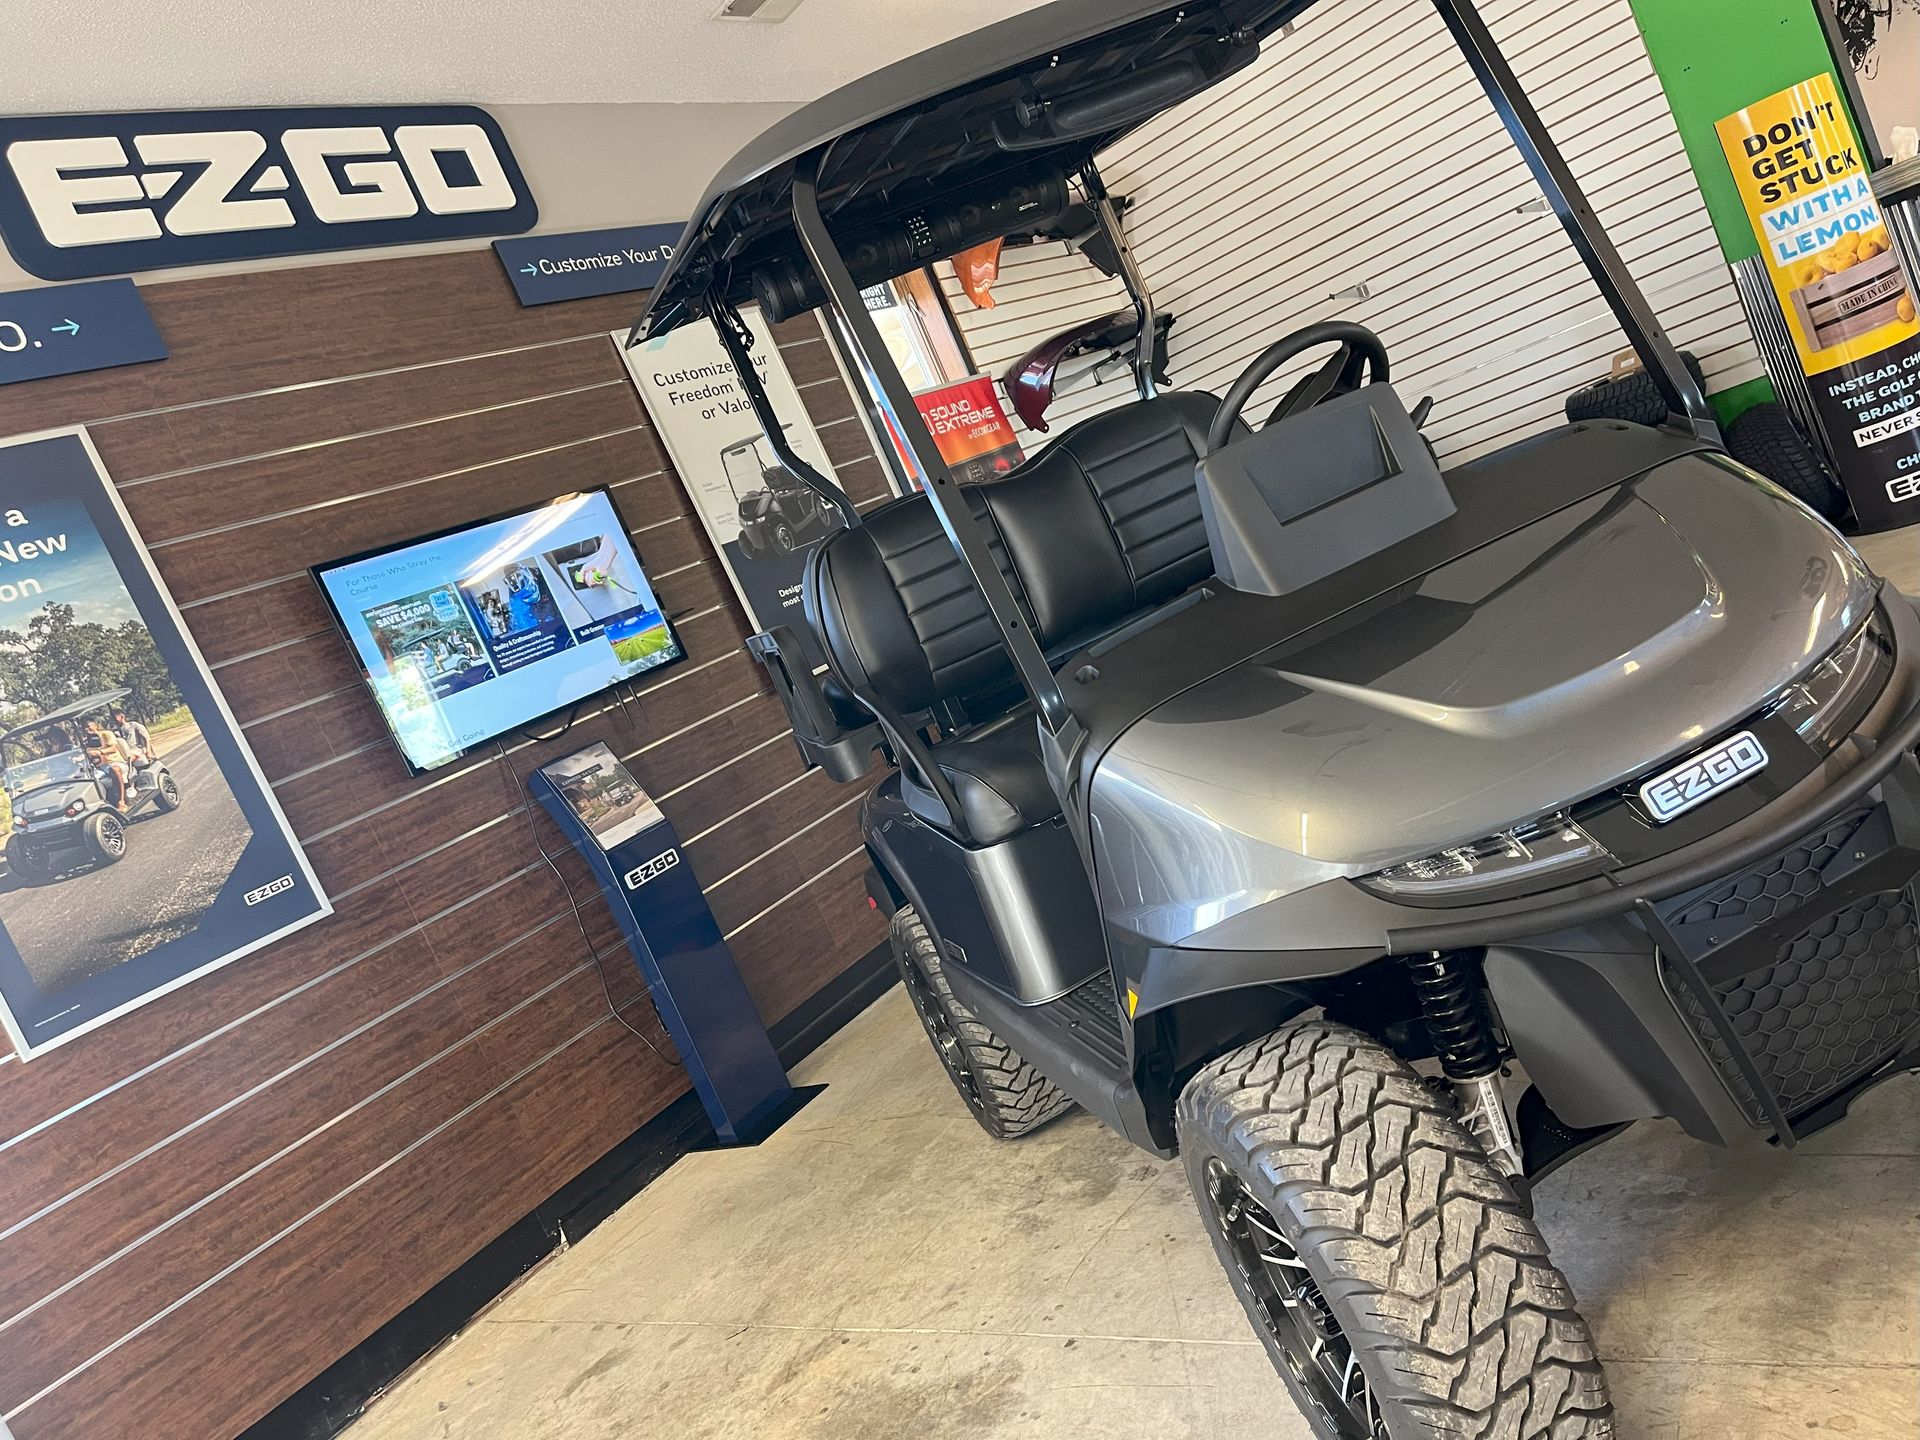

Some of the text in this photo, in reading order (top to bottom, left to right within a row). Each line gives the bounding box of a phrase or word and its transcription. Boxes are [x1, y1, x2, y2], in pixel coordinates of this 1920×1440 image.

[1743, 102, 1835, 158] DON'T
[1752, 138, 1814, 179] GET
[1760, 147, 1857, 203] STUCK
[1767, 178, 1868, 231] WITH A
[1778, 205, 1878, 261] LEMON.
[539, 245, 675, 275] Customize Your D
[1841, 294, 1867, 312] MADE
[1866, 289, 1877, 301] IN
[653, 362, 733, 387] Customize
[1828, 350, 1920, 397] INSTEAD, CH
[668, 383, 734, 406] Freedom
[1842, 390, 1877, 410] THE
[1879, 373, 1916, 397] GOLF
[701, 398, 751, 420] or Valo
[929, 400, 971, 421] SOUND
[935, 406, 995, 434] EXTREME
[1858, 394, 1915, 423] BRAND
[1859, 416, 1914, 442] NEVER
[1896, 453, 1920, 470] CH
[4, 509, 29, 527] a
[346, 578, 361, 588] For
[361, 572, 386, 584] Those
[386, 565, 407, 576] Who
[407, 559, 428, 571] Stray
[350, 583, 379, 597] Course
[778, 583, 803, 598] Design
[782, 595, 801, 608] most
[376, 613, 402, 628] SAVE
[400, 604, 431, 621] $4,000
[448, 729, 486, 748] Get Going
[1650, 738, 1762, 813] EZGO
[629, 851, 678, 887] EZGO
[247, 877, 292, 904] EZGO
